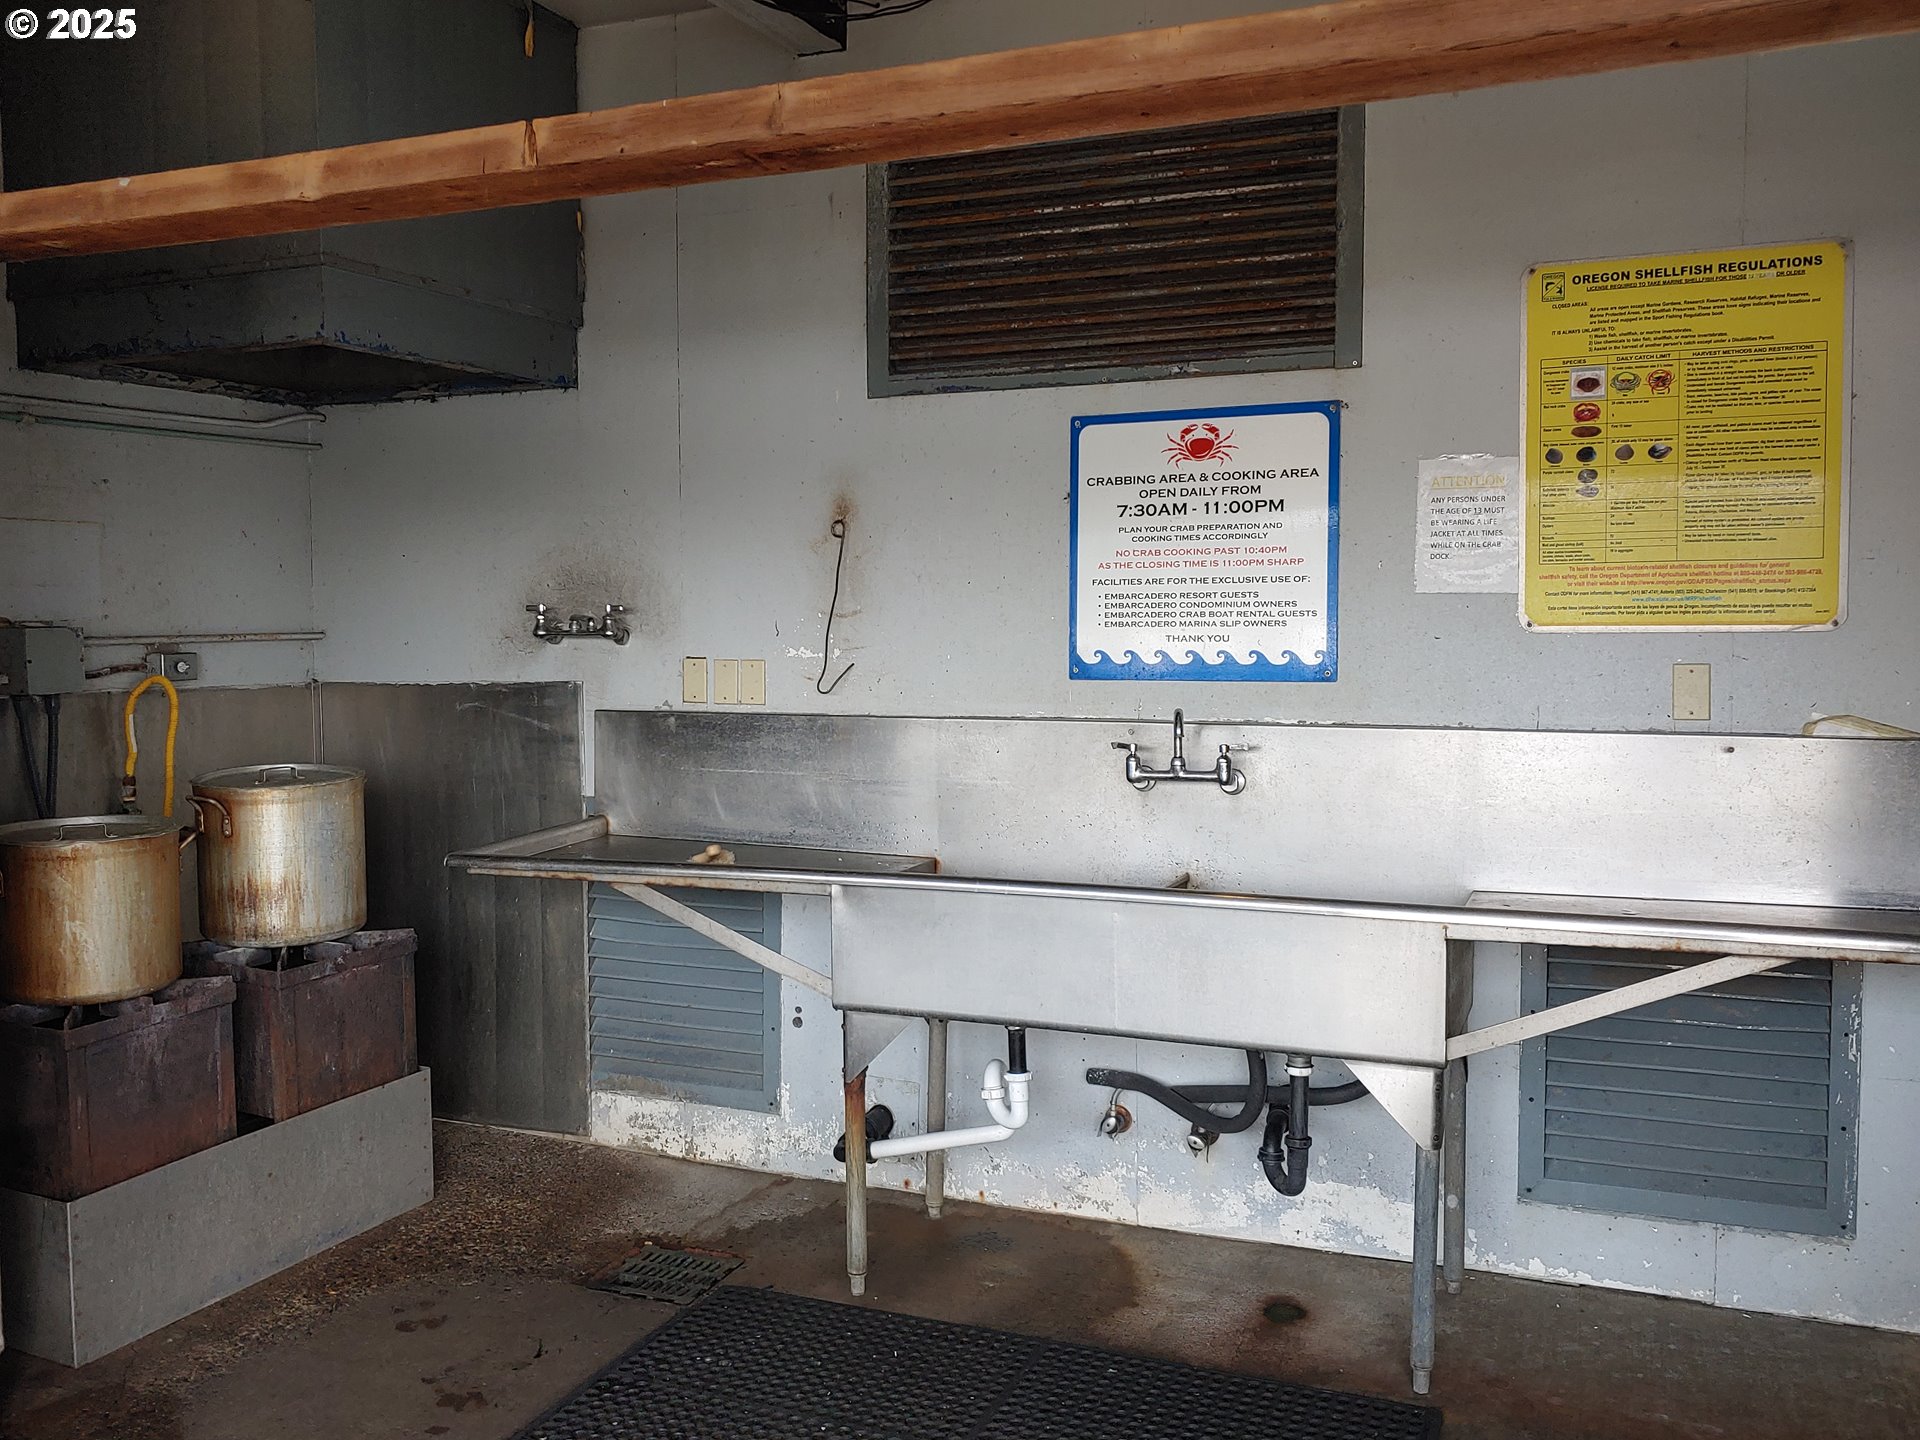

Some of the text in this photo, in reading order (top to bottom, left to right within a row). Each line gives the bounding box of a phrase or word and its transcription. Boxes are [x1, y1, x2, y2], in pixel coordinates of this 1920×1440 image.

[1572, 256, 1823, 285] OREGON SHELLFISH REGULATIONS
[1087, 468, 1320, 487] CRABBING AREA & COOKING AREA
[1139, 485, 1262, 498] OPEN DAILY FROM
[1117, 503, 1187, 517] 7:30AM
[1204, 499, 1285, 514] 11:00PM
[1474, 507, 1482, 516] 13
[1197, 523, 1260, 531] PREPARATION
[1203, 532, 1269, 540] ACCORDINGLY
[1164, 548, 1211, 556] COOKING
[1135, 561, 1180, 569] CLOSING
[1267, 558, 1305, 566] SHARP
